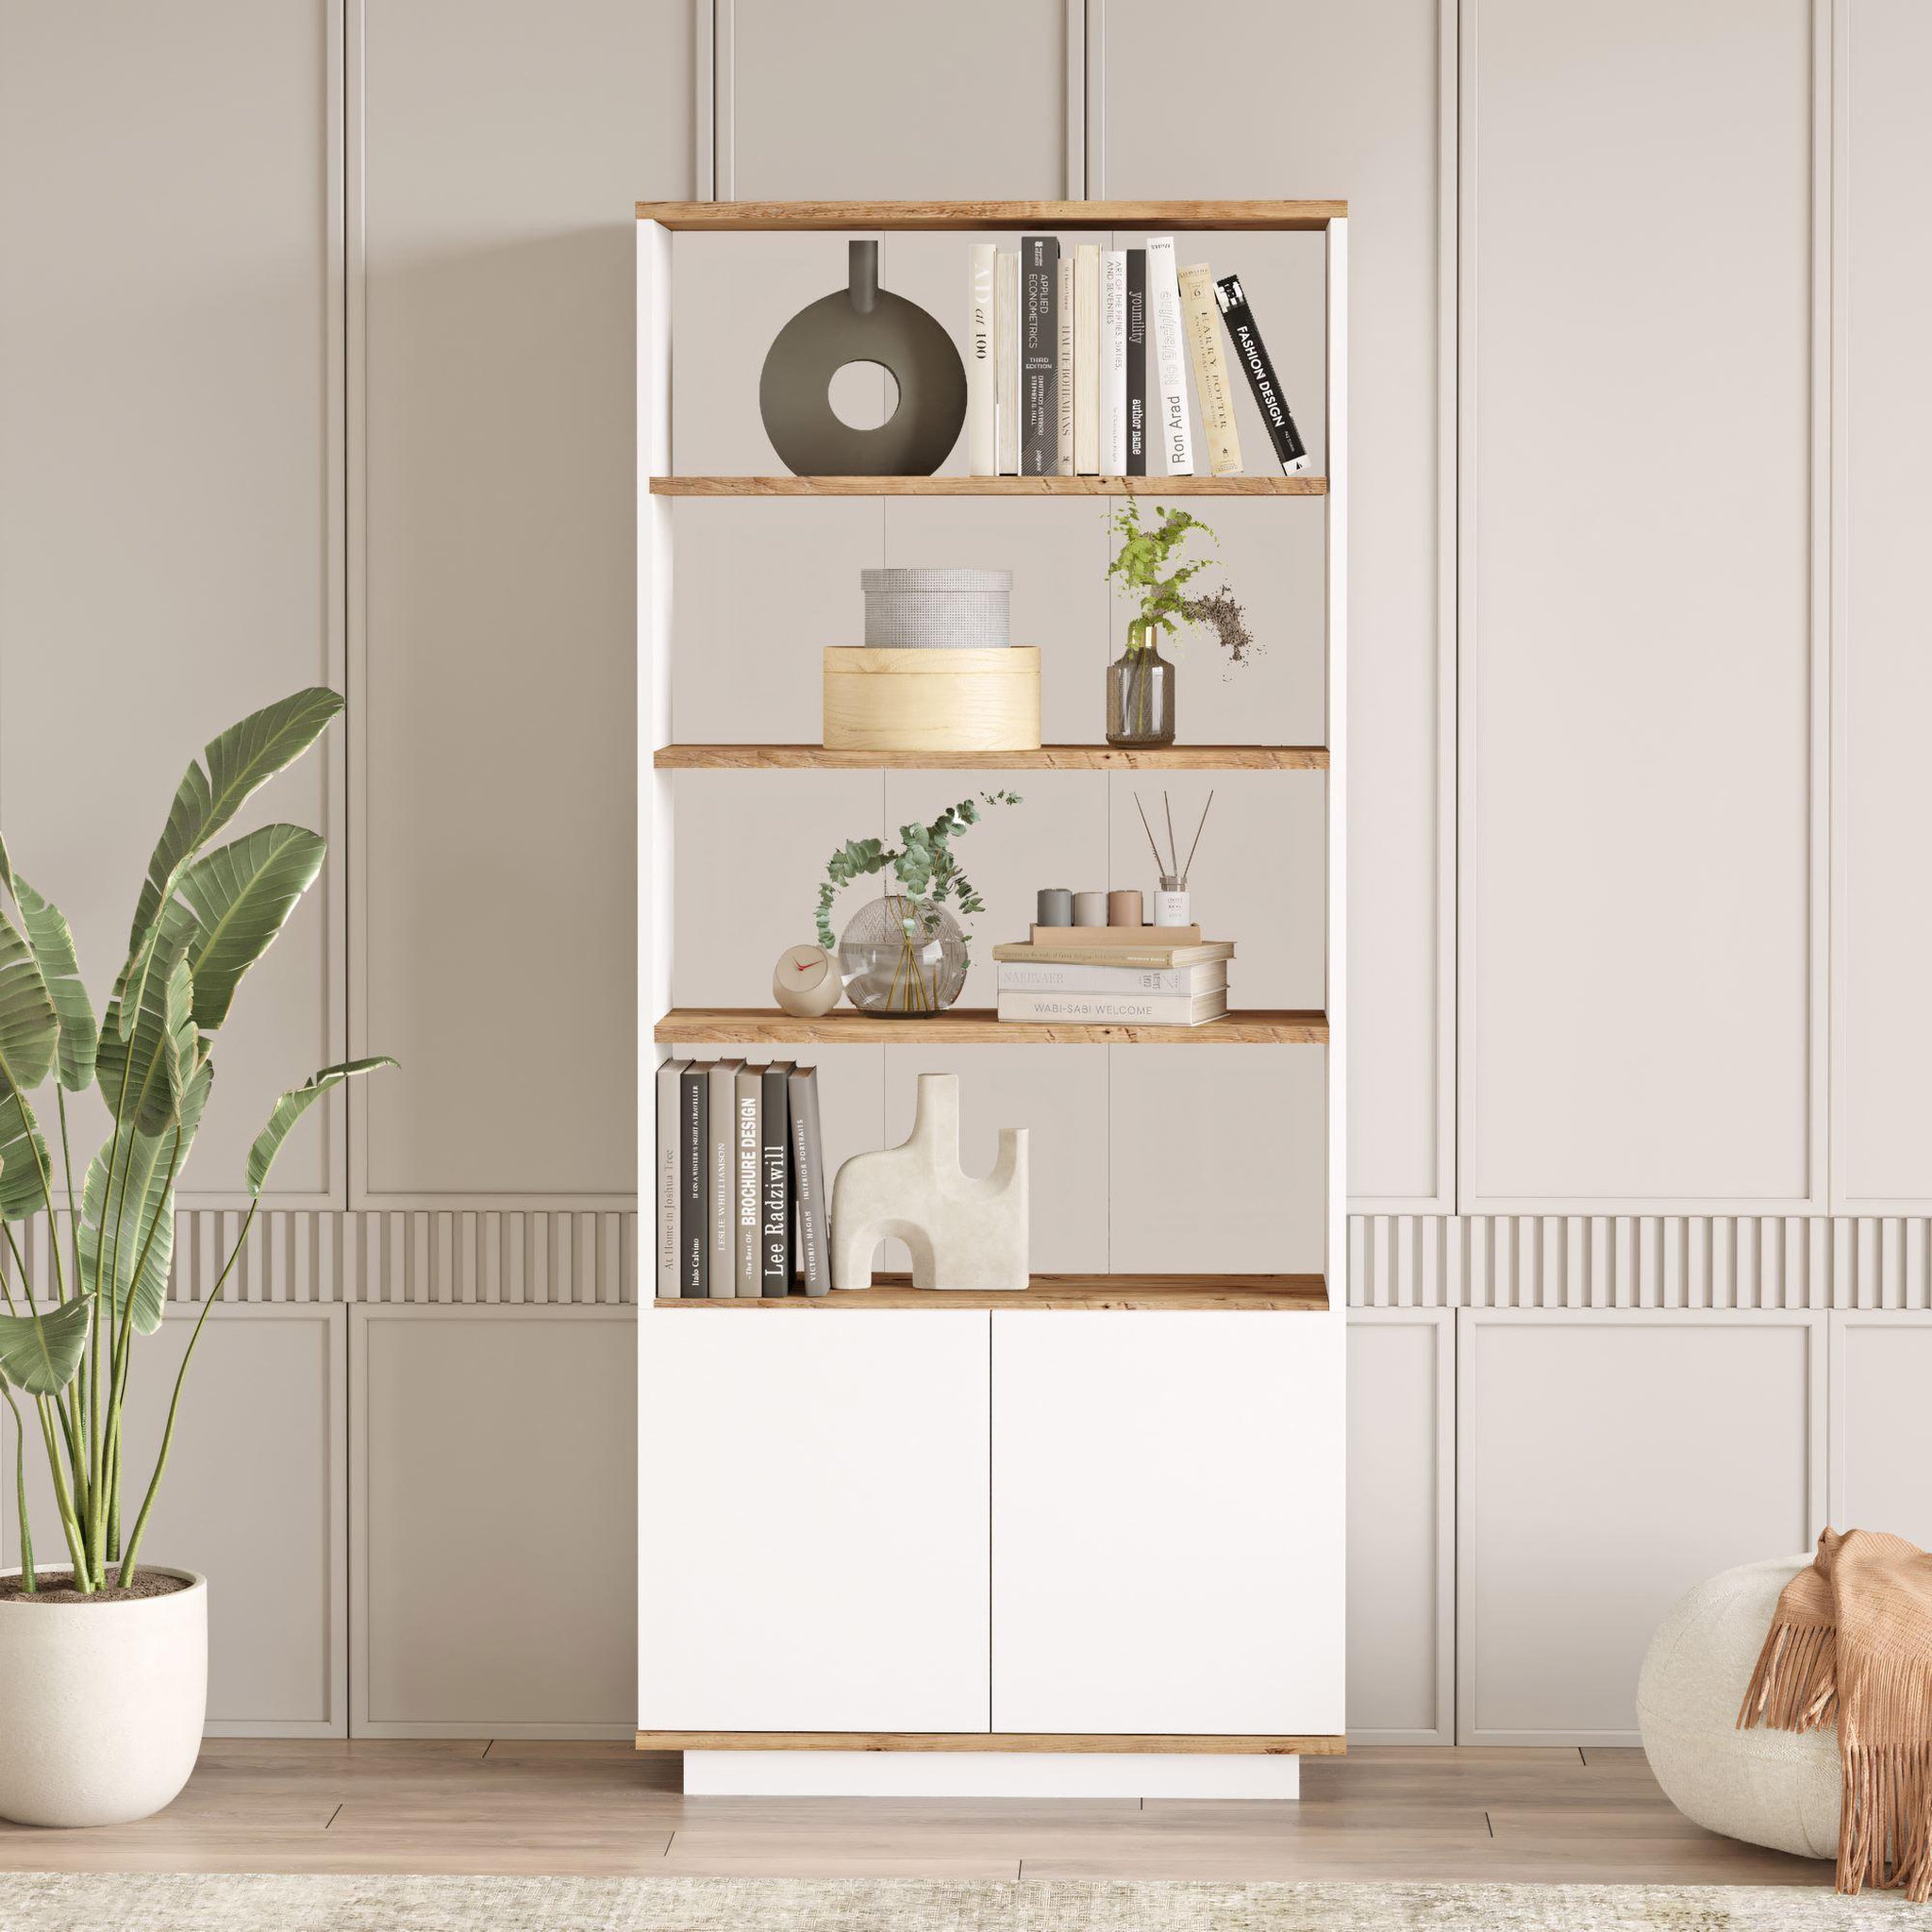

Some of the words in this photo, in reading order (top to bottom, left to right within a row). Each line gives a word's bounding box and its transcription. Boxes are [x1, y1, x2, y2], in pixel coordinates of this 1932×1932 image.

[1028, 275, 1038, 348] ECONOMETRICS
[1040, 275, 1048, 313] APPLIED
[1129, 291, 1144, 343] youmility
[975, 332, 986, 358] 100
[1201, 311, 1217, 366] HARRY
[1213, 375, 1227, 429] POTTER
[1237, 325, 1267, 380] FASHION
[1258, 380, 1286, 427] DESIGN
[1132, 399, 1142, 428] author
[1169, 395, 1183, 433] Arad
[1132, 431, 1142, 455] name
[1172, 437, 1185, 464] Ron
[1034, 1004, 1091, 1014] WABI-SABI
[1095, 1005, 1153, 1015] WELCOME
[741, 1098, 757, 1147] DESIGN
[797, 1119, 806, 1160] PORTRAITS
[665, 1175, 676, 1208] Joshua
[741, 1152, 757, 1225] BROCHURE
[764, 1145, 784, 1236] Radziwill
[801, 1163, 809, 1200] INTERIOR
[665, 1212, 673, 1222] in
[665, 1257, 673, 1271] At
[765, 1243, 784, 1276] Lee
[808, 1241, 817, 1281] VICTORIA
